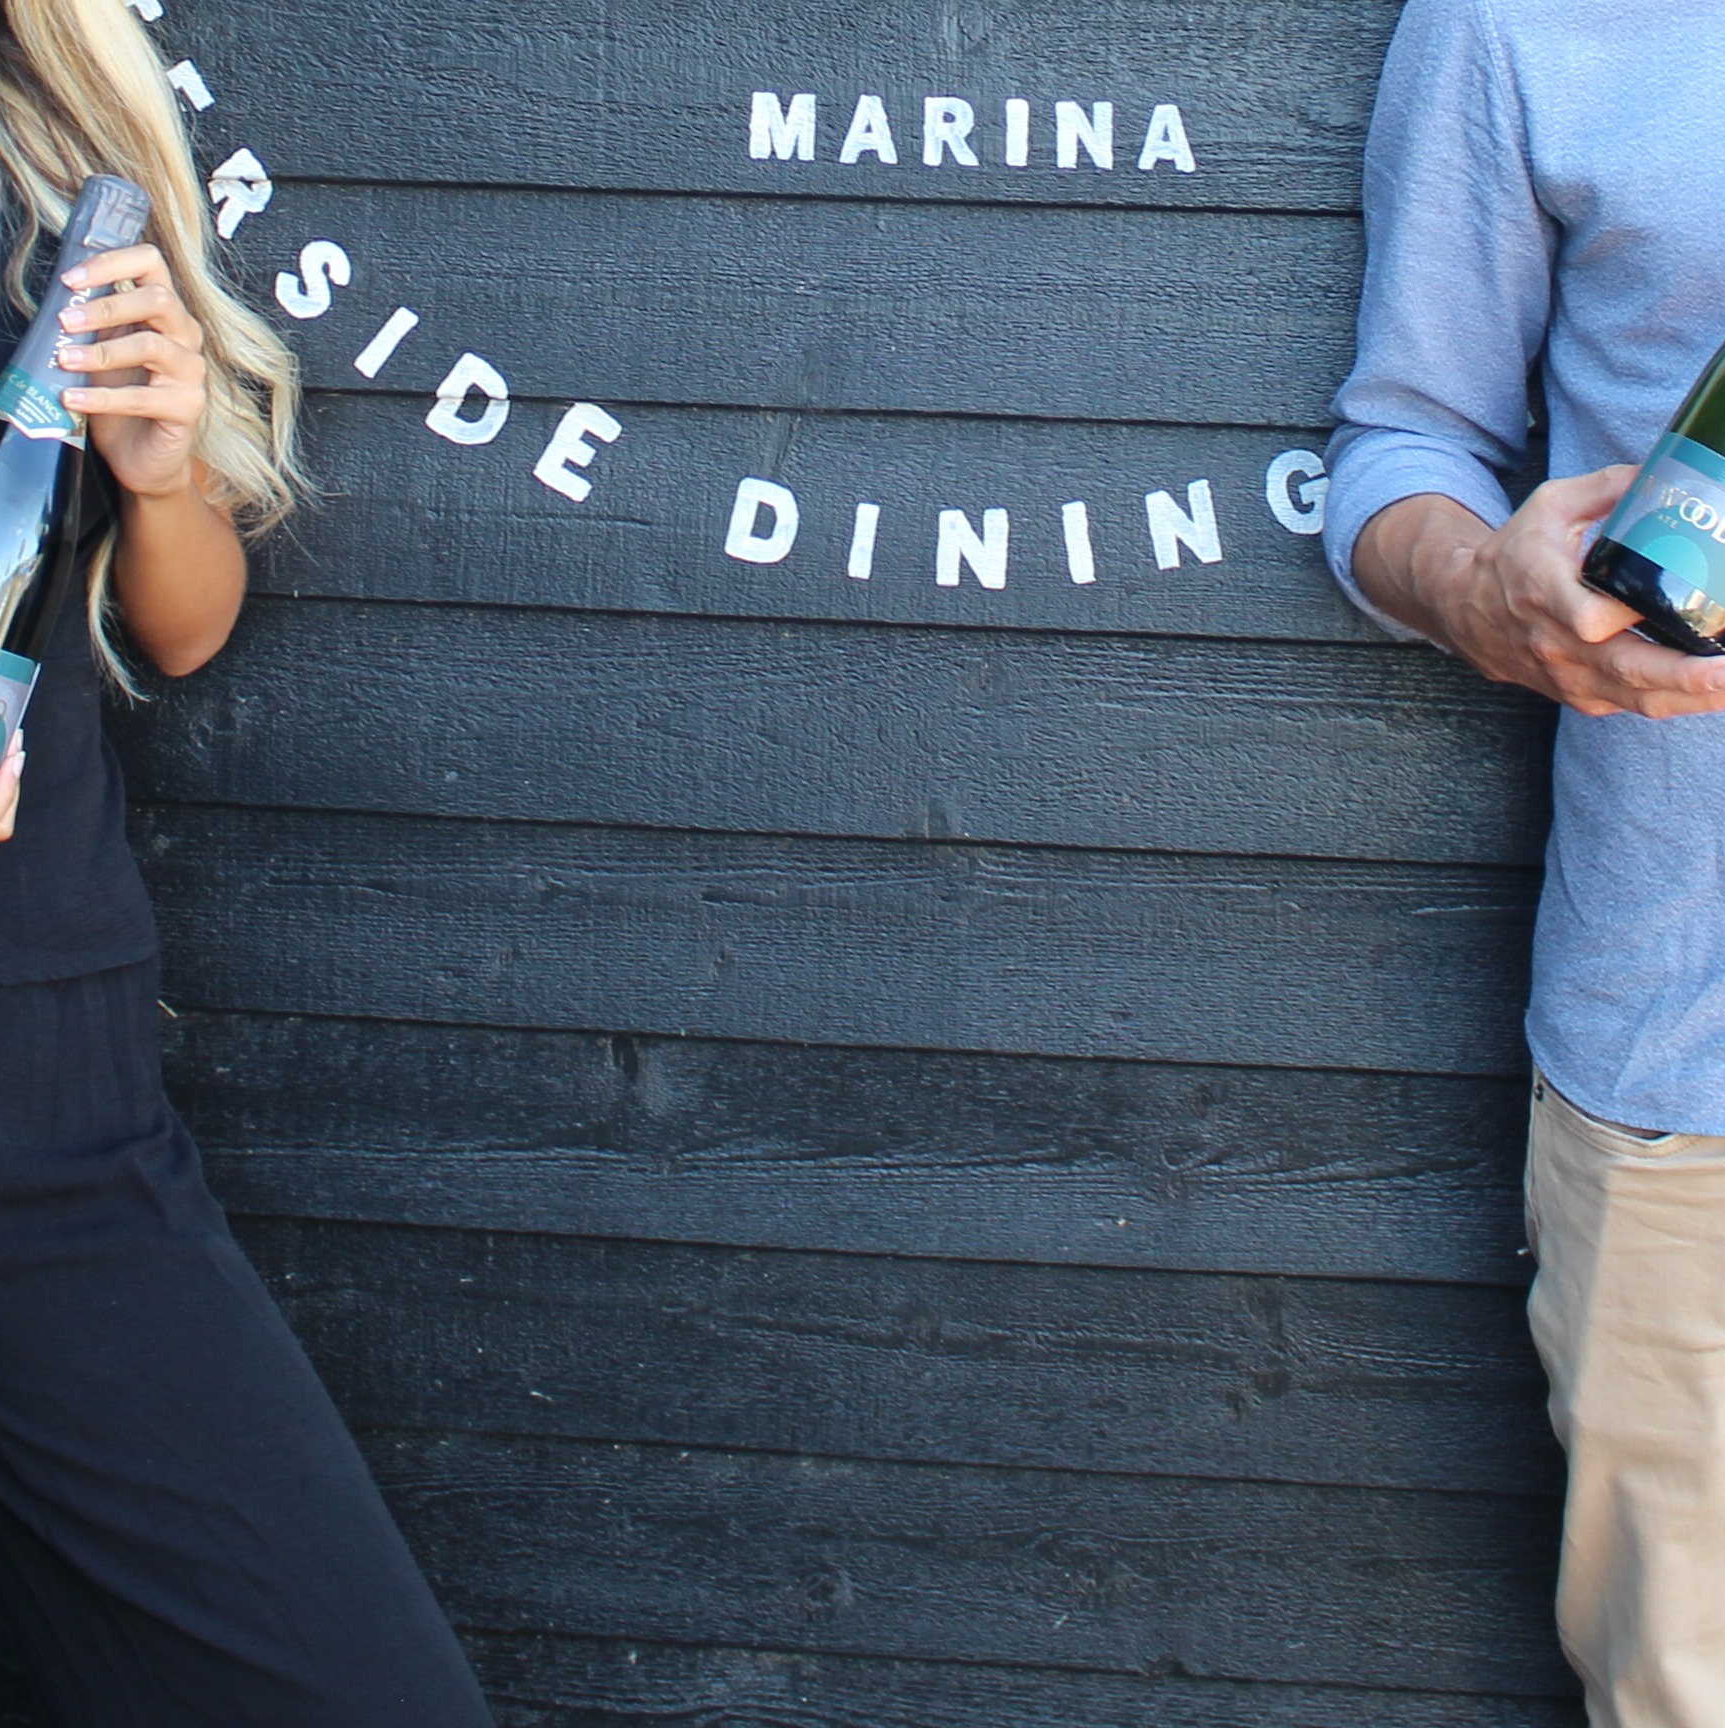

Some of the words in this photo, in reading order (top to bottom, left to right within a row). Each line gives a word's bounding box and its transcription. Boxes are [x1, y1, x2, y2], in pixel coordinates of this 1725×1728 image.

[747, 90, 1197, 174] MARINA
[26, 384, 63, 422] BLANCS
[723, 448, 1330, 591] DINING
